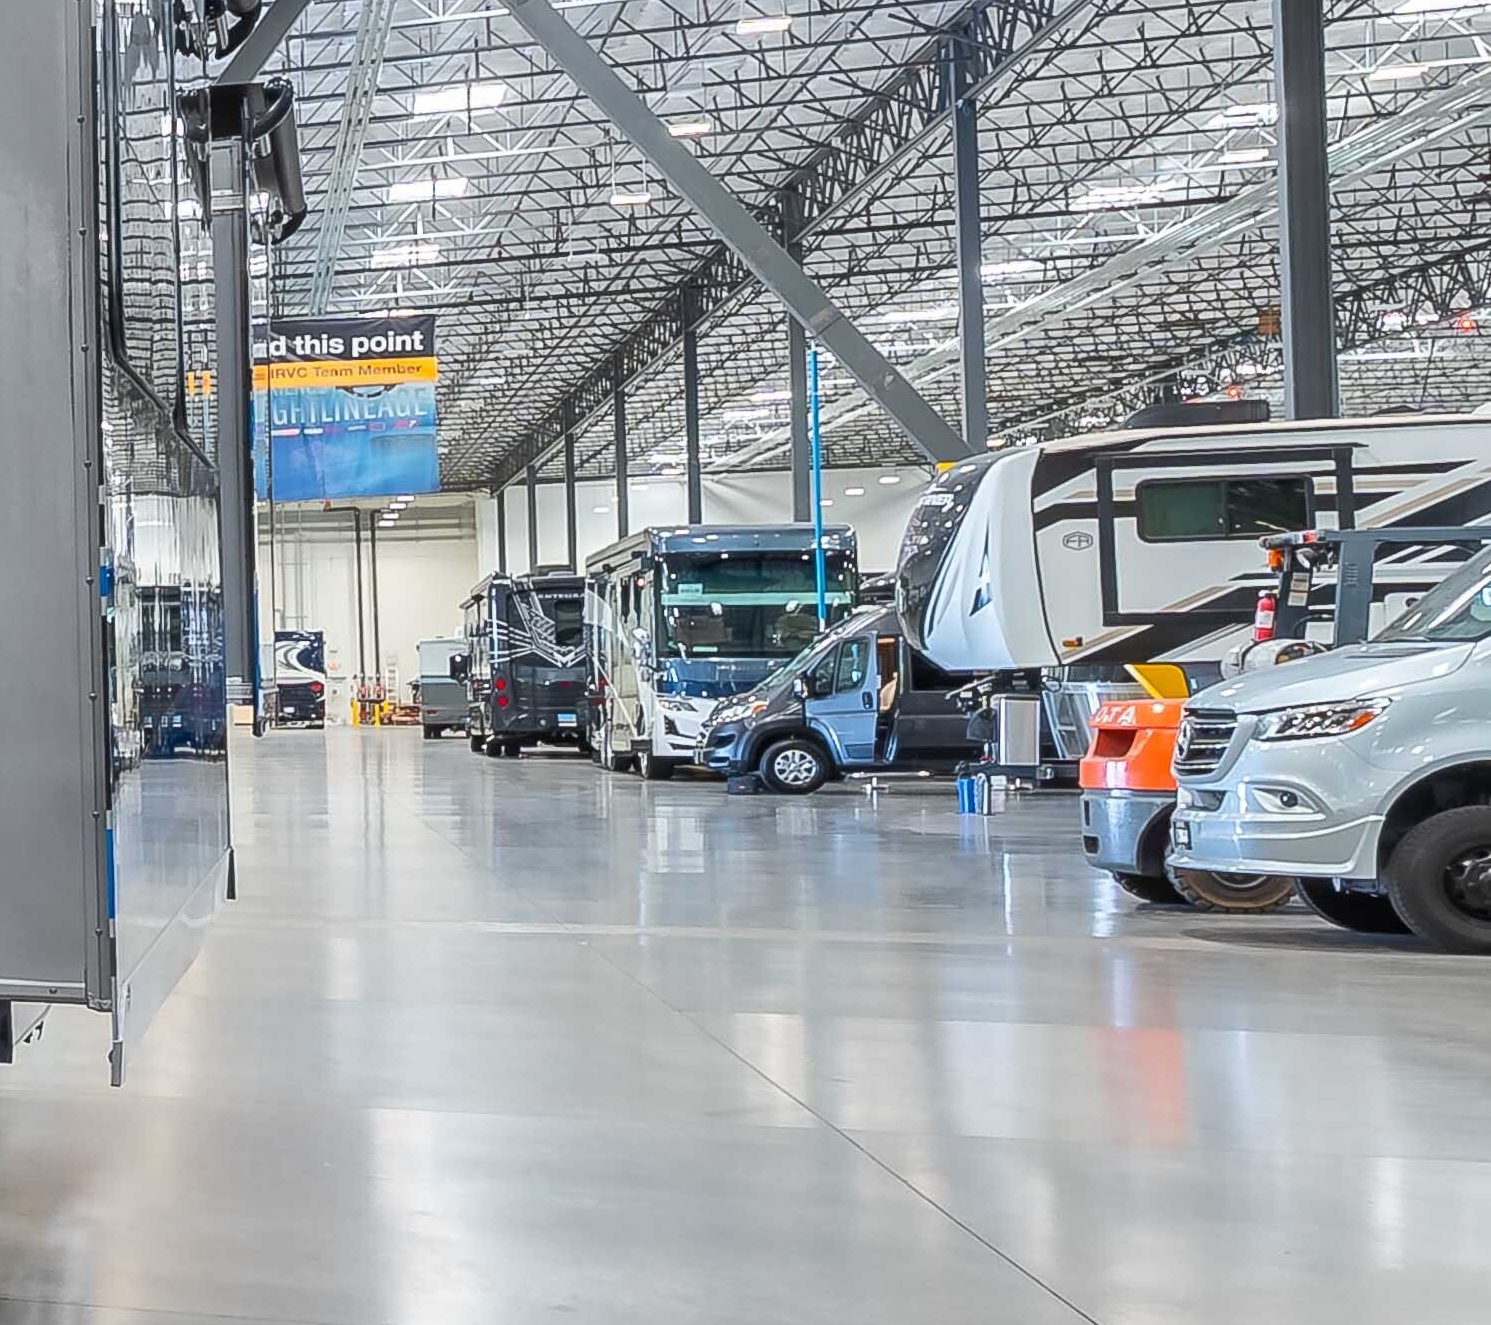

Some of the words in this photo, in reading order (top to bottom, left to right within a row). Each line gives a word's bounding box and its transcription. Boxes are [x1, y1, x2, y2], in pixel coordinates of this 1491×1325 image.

[292, 334, 344, 355] this
[352, 330, 424, 357] point
[358, 363, 423, 376] Member
